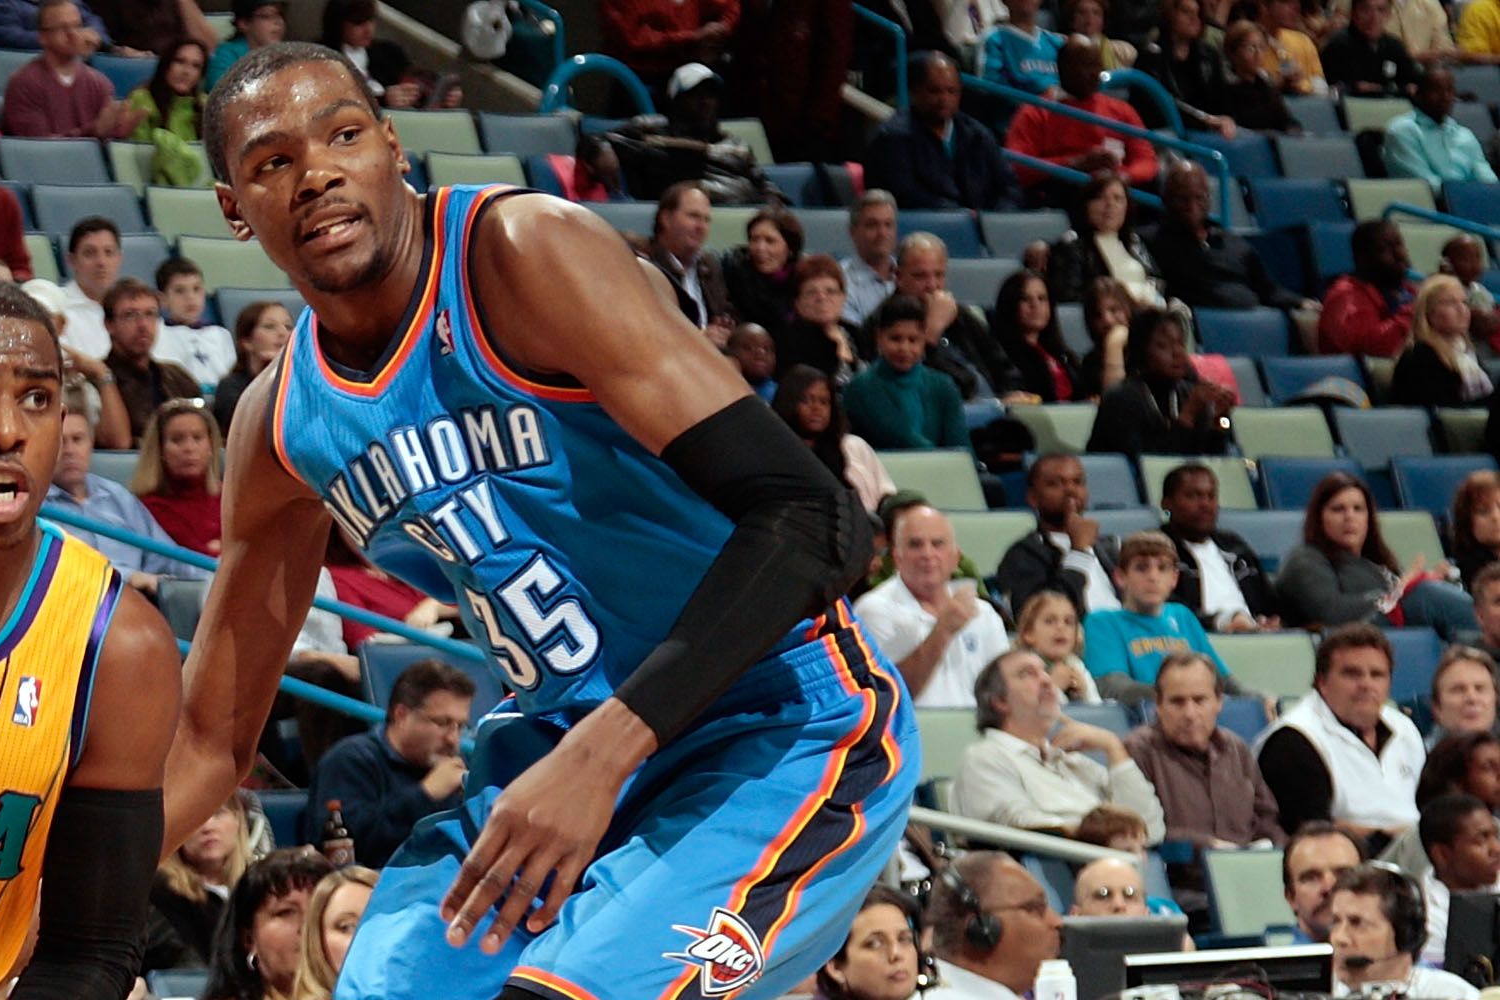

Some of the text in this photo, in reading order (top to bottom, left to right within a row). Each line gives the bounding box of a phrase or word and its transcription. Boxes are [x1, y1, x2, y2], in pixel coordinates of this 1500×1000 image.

[324, 403, 551, 550] OKLAHOMA
[401, 472, 512, 566] CITY
[462, 549, 603, 692] 35
[689, 933, 755, 971] OKC
